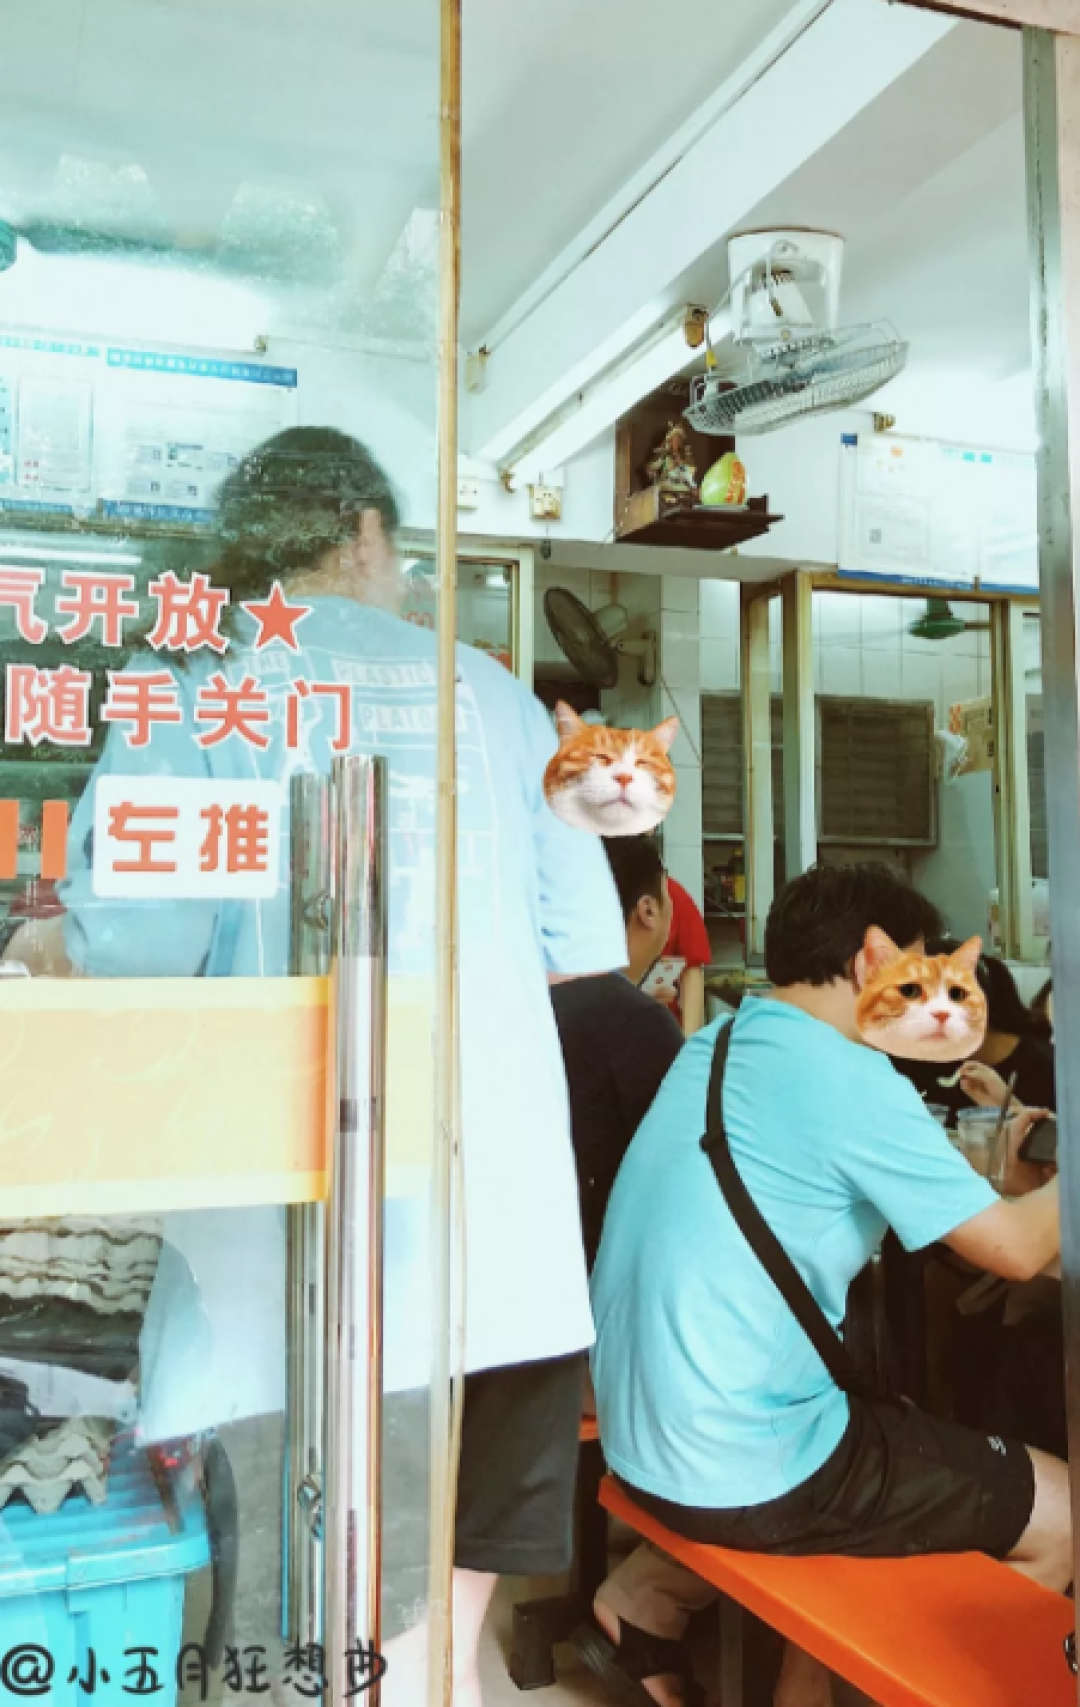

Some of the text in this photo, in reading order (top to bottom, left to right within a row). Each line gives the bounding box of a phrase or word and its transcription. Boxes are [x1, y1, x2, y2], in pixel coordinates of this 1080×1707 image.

[7, 667, 352, 750] 随手关门
[107, 801, 269, 873] 左推
